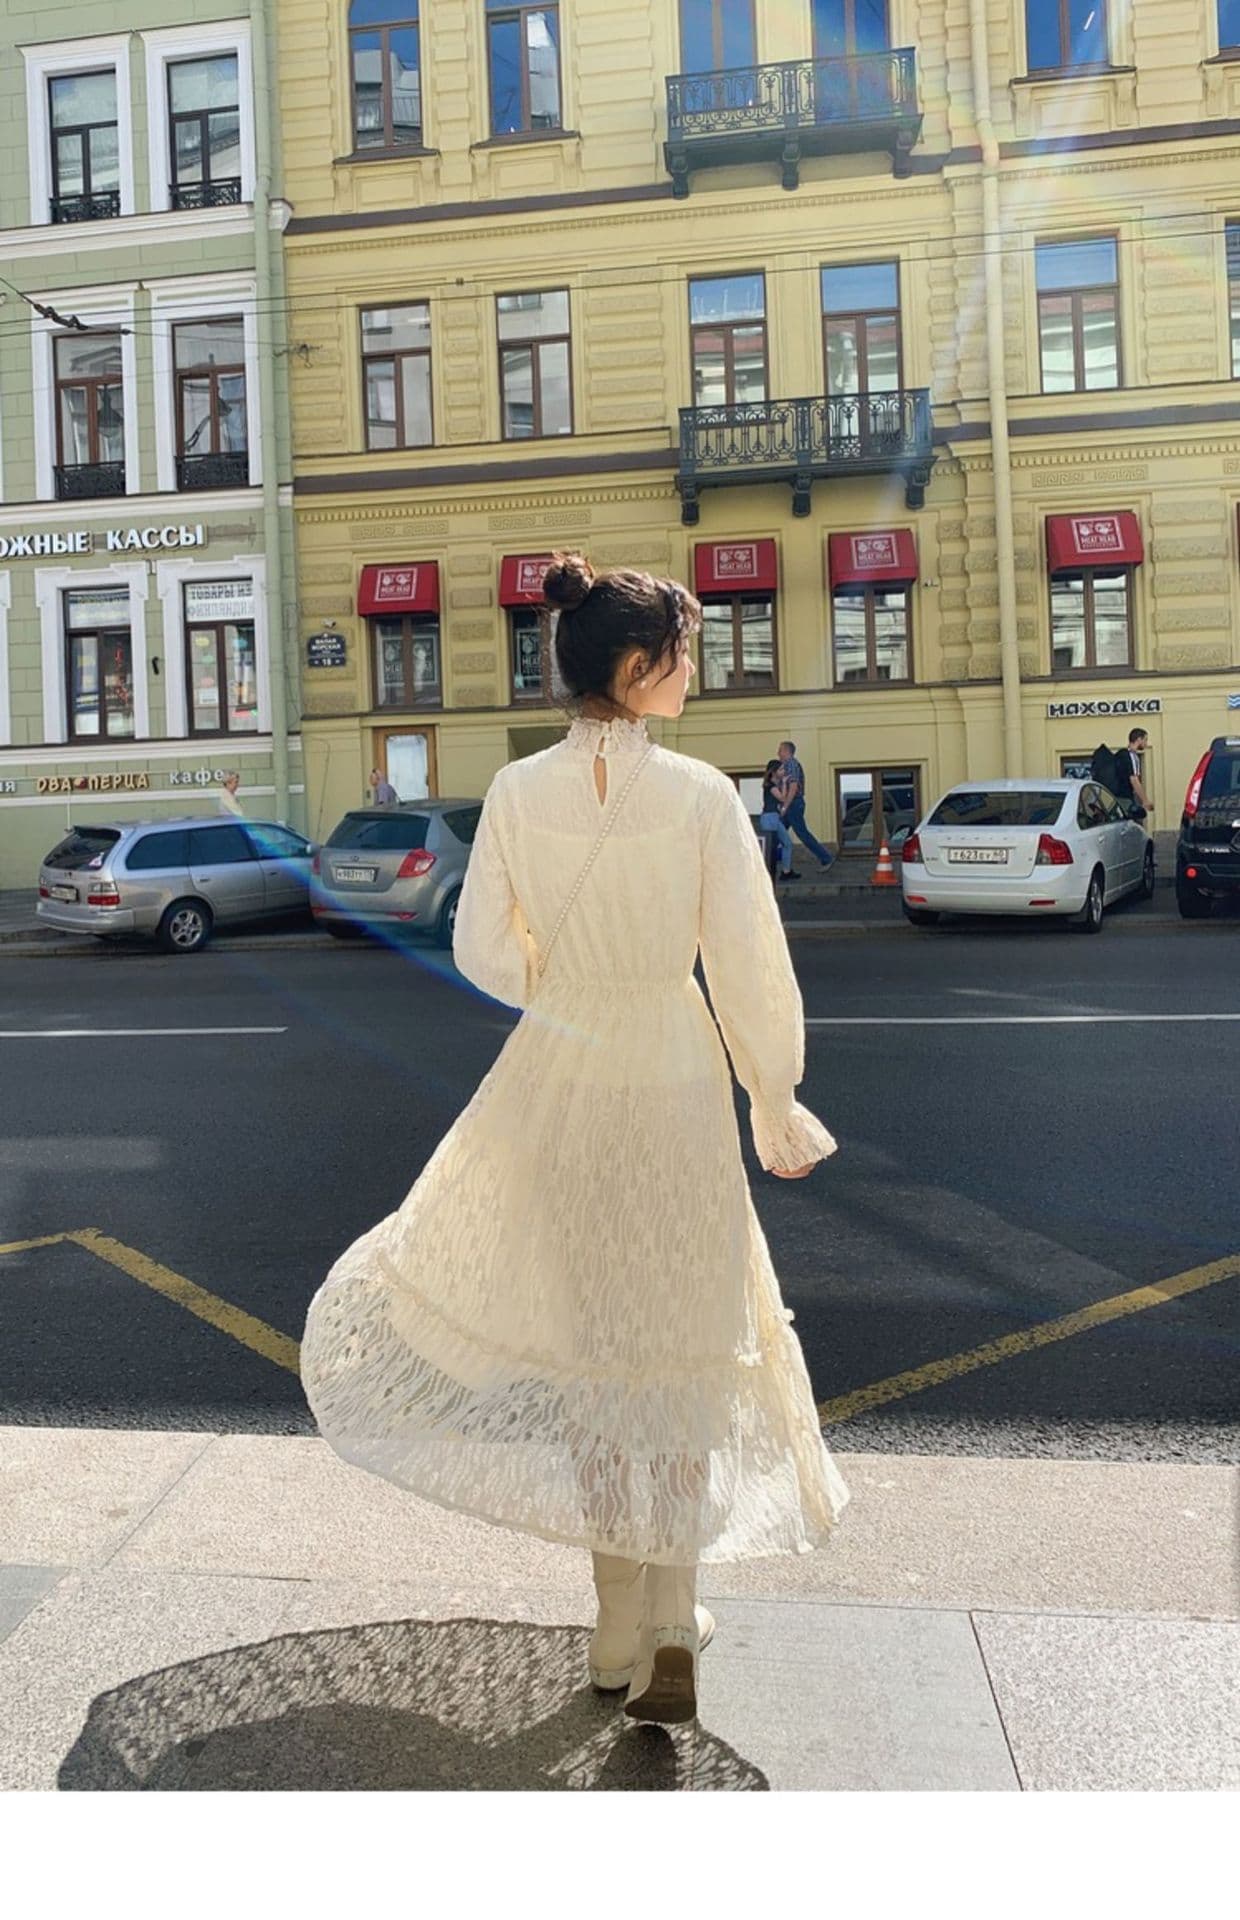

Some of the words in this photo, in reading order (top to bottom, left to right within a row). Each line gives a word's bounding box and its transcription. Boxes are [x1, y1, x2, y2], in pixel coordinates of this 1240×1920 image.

[106, 524, 205, 550] КАССЫ
[190, 585, 234, 600] ТОВАРЫ
[87, 773, 150, 791] ПЕРЦА
[169, 767, 225, 786] кафе
